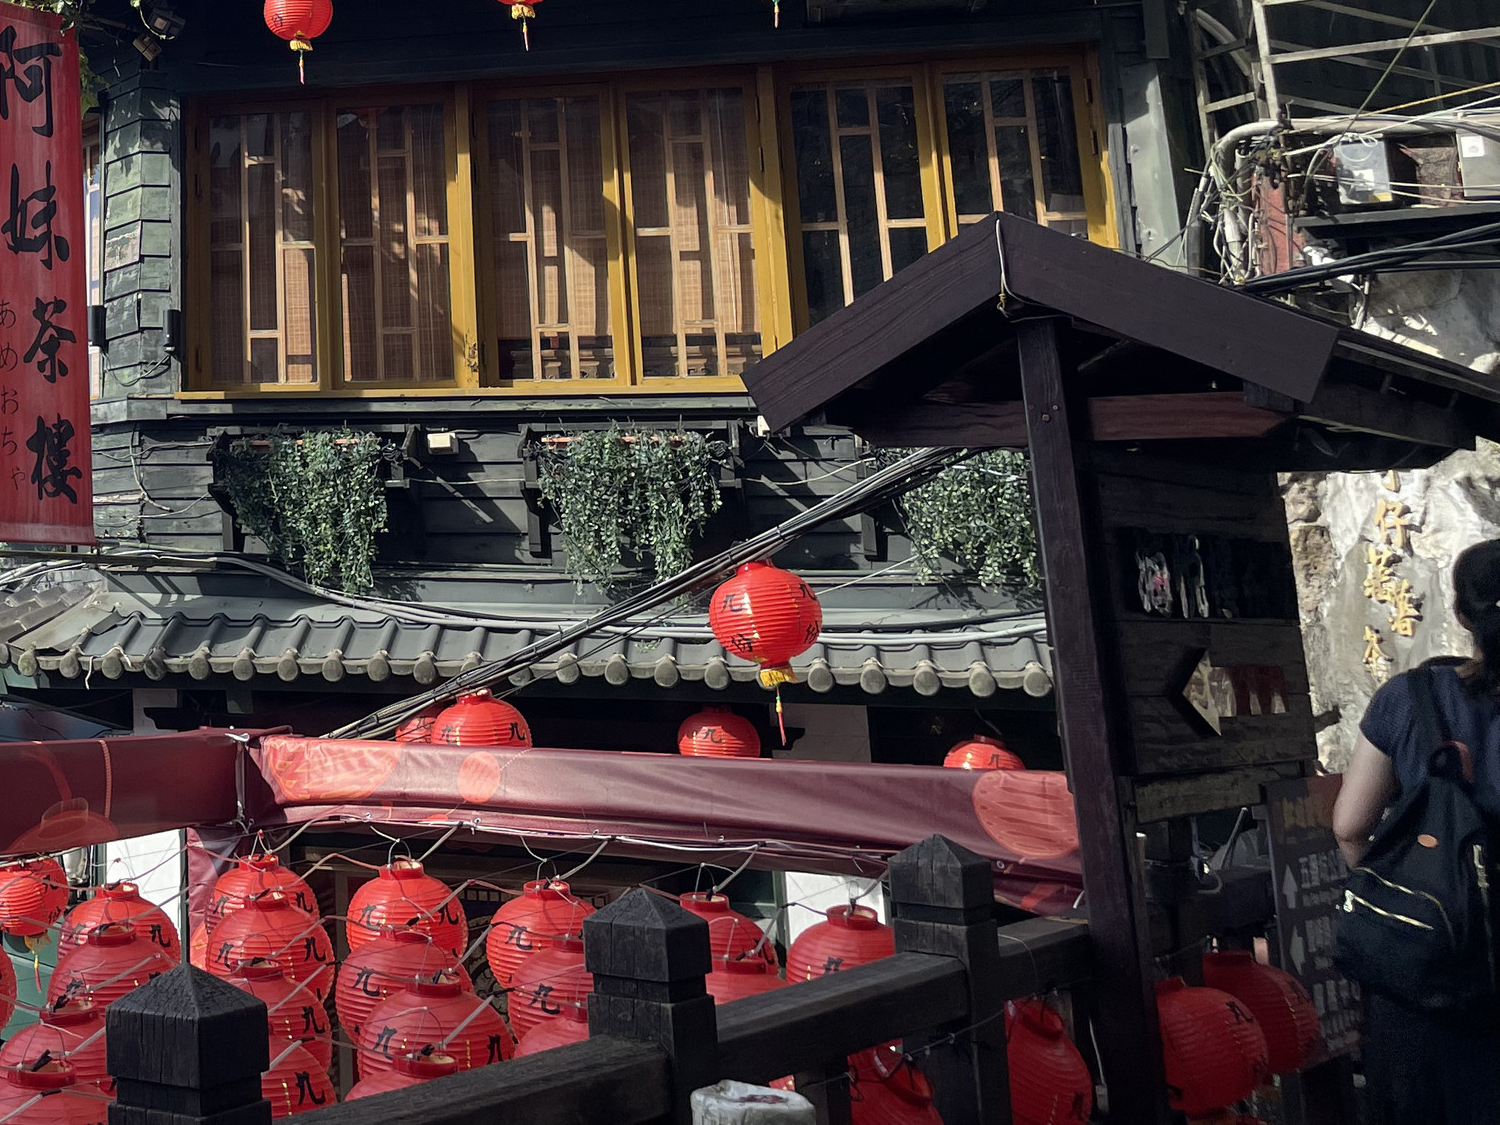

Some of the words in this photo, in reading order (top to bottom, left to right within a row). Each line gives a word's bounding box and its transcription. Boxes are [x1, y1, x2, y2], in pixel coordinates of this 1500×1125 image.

[295, 892, 314, 914] 九
[303, 936, 326, 962] 九
[505, 926, 533, 951] 九
[529, 983, 561, 1015] 九
[301, 1005, 326, 1035] 九
[294, 1071, 326, 1106] 九
